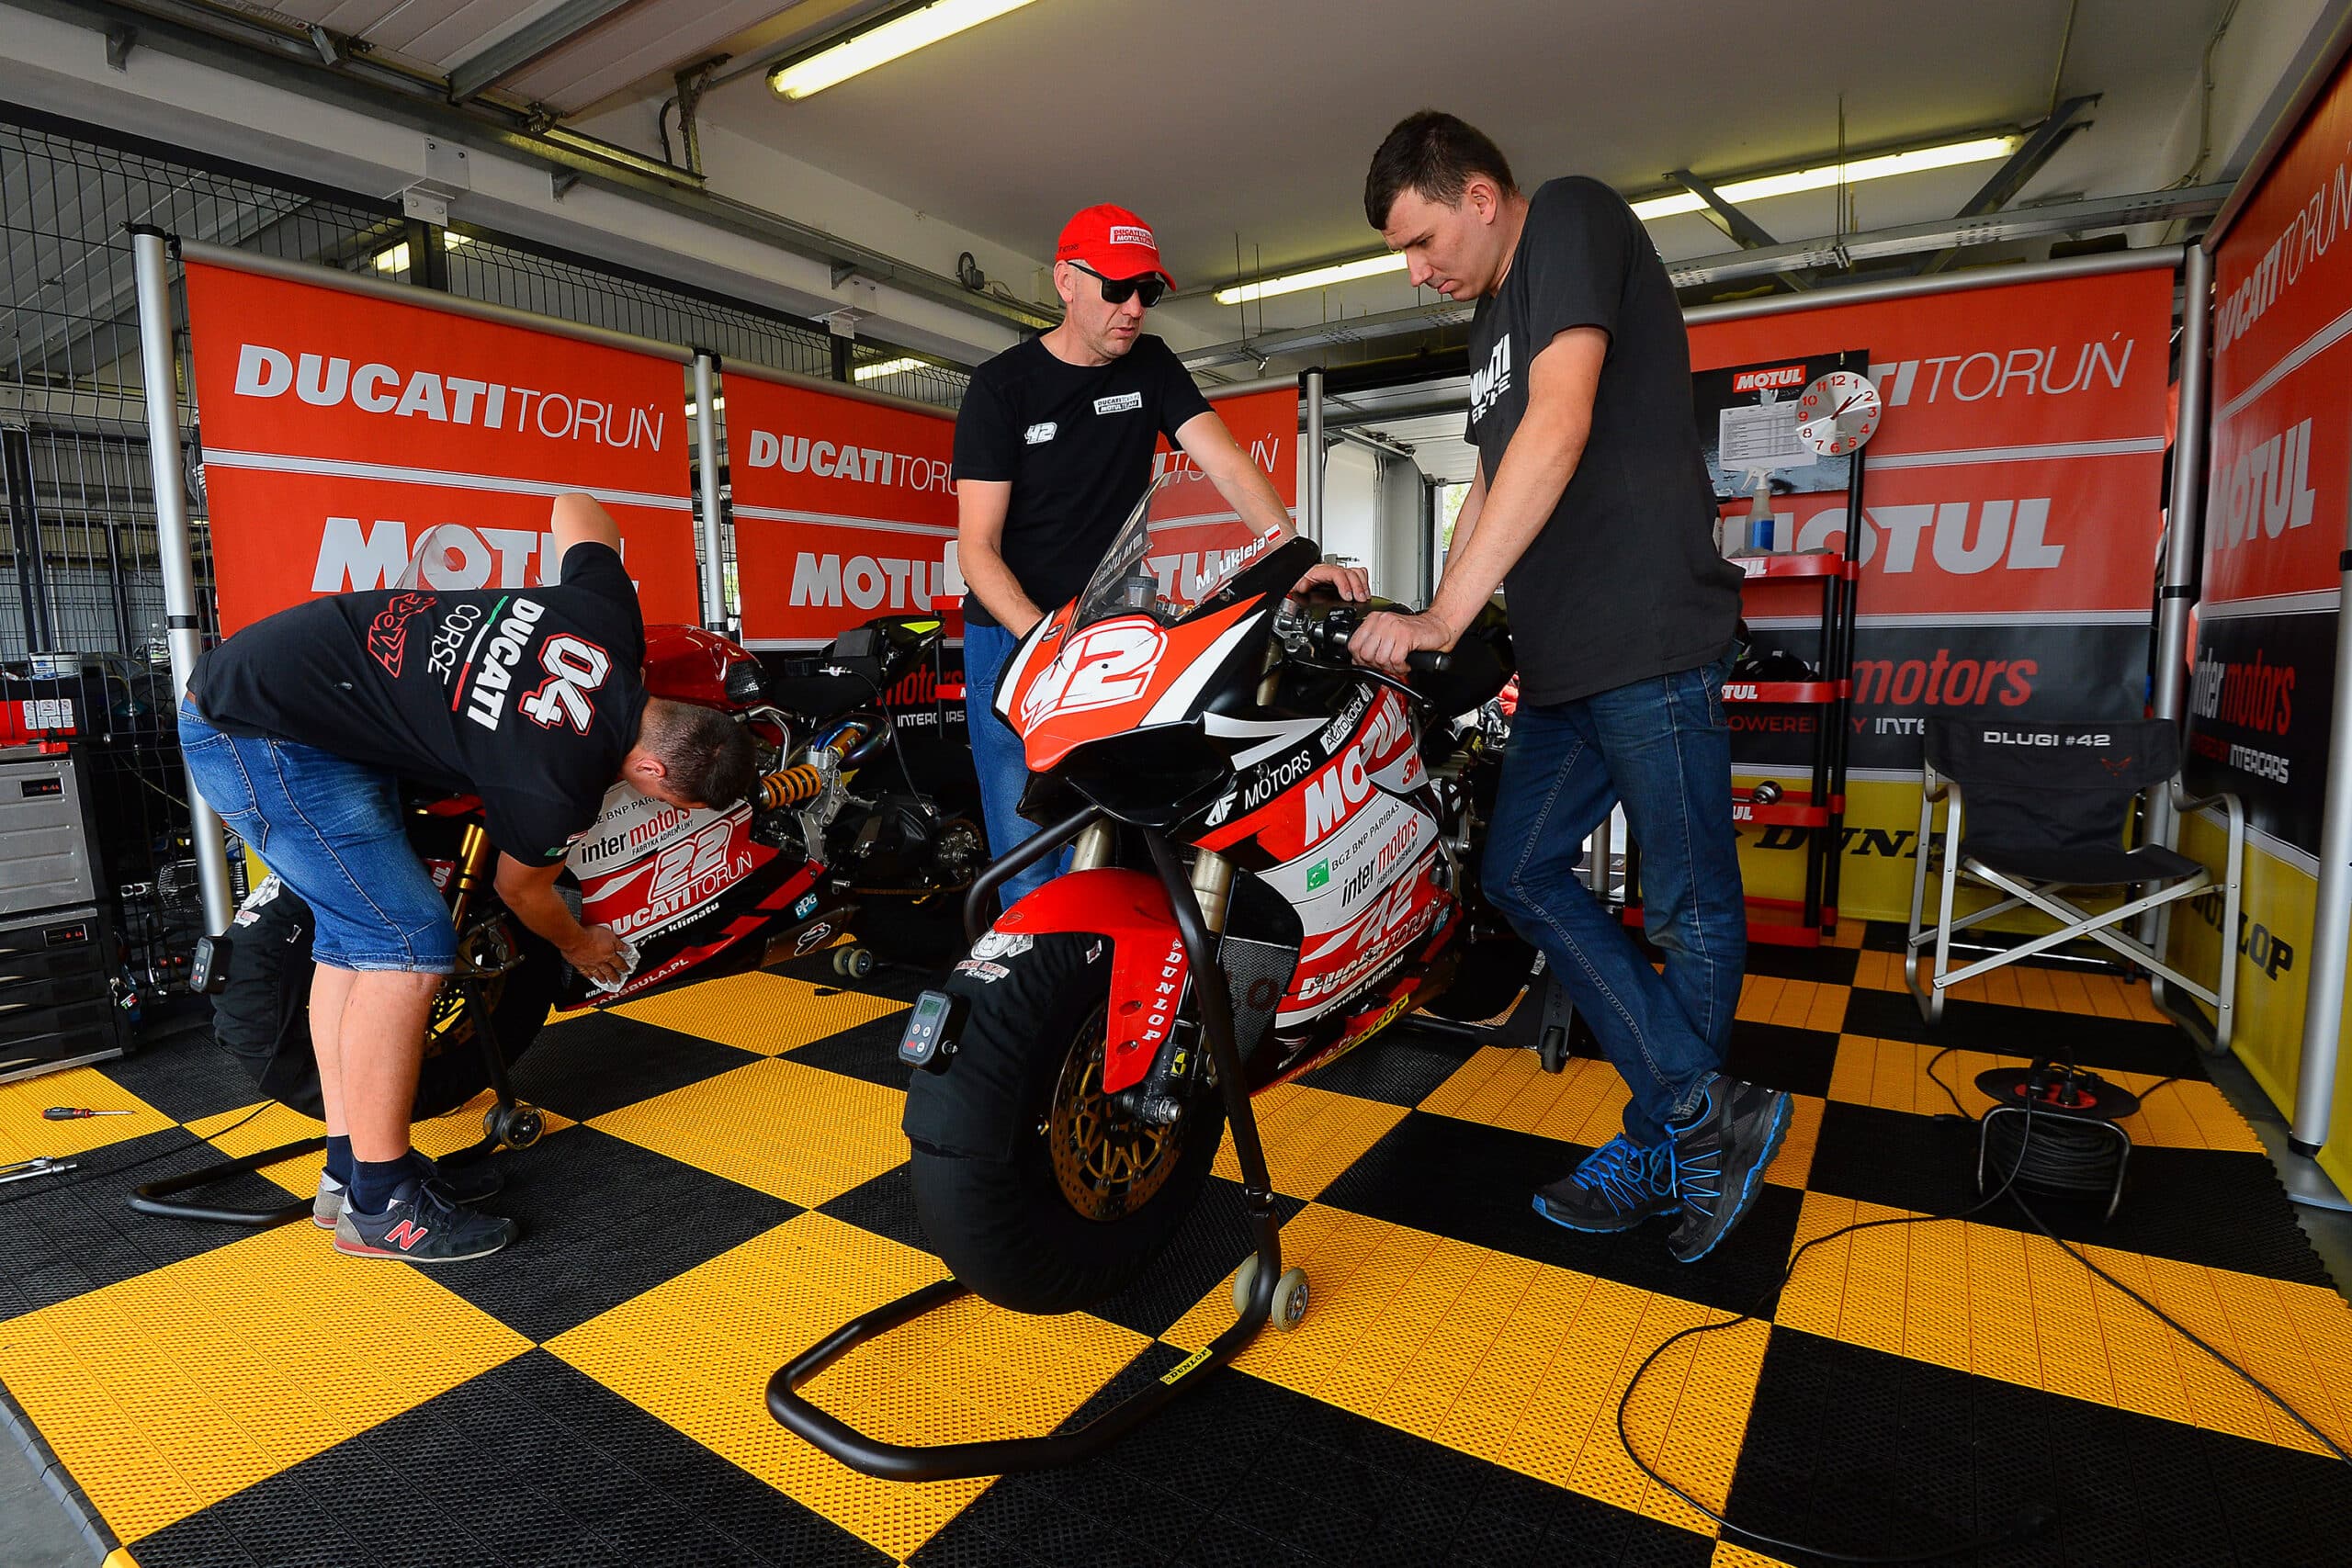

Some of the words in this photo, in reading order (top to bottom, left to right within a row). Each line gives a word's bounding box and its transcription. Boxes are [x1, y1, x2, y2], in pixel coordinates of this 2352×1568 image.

[1736, 368, 1802, 389] MOTUL
[1816, 381, 1826, 392] 11
[1831, 375, 1846, 386] 12
[1853, 378, 1859, 389] 1
[1803, 396, 1818, 406] 10
[1864, 390, 1873, 401] 2
[1798, 412, 1809, 422] 9
[1868, 407, 1877, 417] 3
[1024, 422, 1057, 445] 42
[1803, 428, 1813, 438] 8
[1849, 437, 1857, 447] 5
[1860, 423, 1870, 434] 4
[1815, 440, 1824, 450] 7
[1830, 442, 1840, 453] 6
[2210, 418, 2316, 550] MOTUL
[311, 517, 639, 592] MOT
[1219, 536, 1266, 575] Ukleja
[789, 552, 943, 611] MOTU
[427, 604, 481, 685] CORSE
[467, 597, 546, 731] DUCATI
[1022, 619, 1169, 738] 42
[1852, 649, 2038, 706] motors
[518, 632, 613, 736] 04
[1722, 685, 1758, 699] TUL
[2222, 648, 2295, 736] motors
[1727, 715, 1818, 733] OWERE
[1851, 717, 1867, 733] Y
[1983, 731, 2059, 746] DLUGI
[2065, 734, 2110, 747] #42
[1245, 750, 1311, 810] MOTORS
[1402, 753, 1421, 784] 3M
[606, 805, 628, 820] BNP
[1352, 832, 1368, 854] BNP
[1369, 801, 1400, 838] PARIBAS
[581, 832, 627, 864] inter
[632, 839, 659, 856] FABRYKA
[648, 819, 733, 905] 22
[1341, 856, 1375, 908] inter
[1378, 813, 1419, 874] motors
[669, 902, 719, 931] klimatu
[795, 893, 817, 917] PPG
[1356, 863, 1419, 951] 42
[1142, 951, 1182, 1041] DUNLOP
[385, 1219, 428, 1251] N
[1170, 1348, 1208, 1378] DUNLOP
